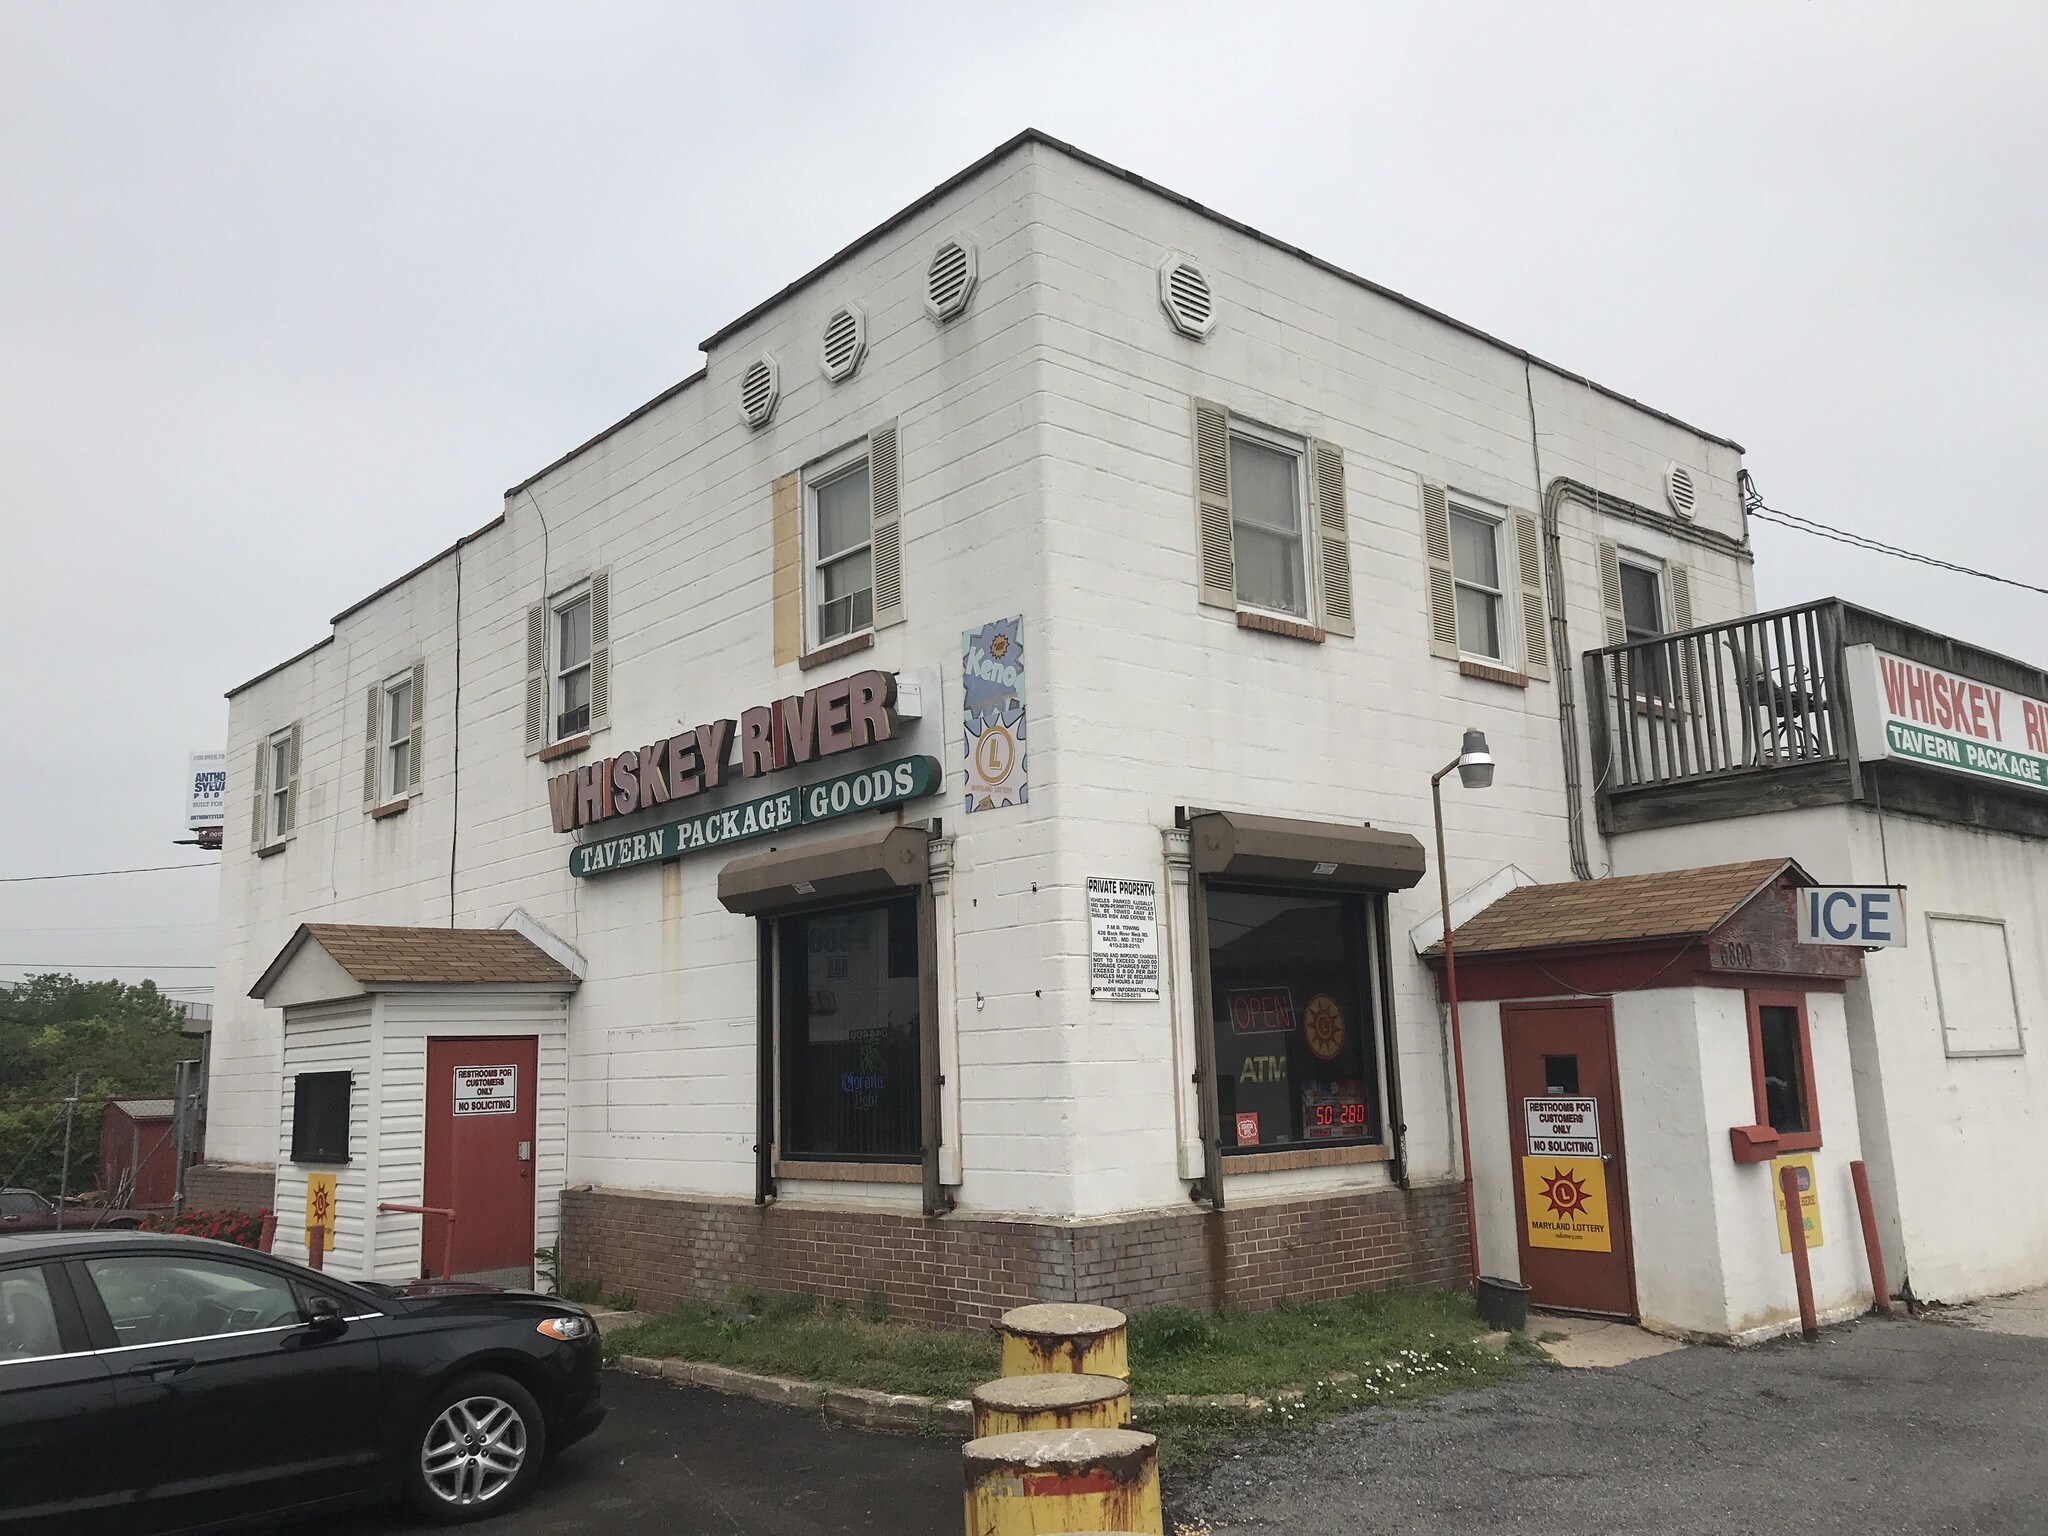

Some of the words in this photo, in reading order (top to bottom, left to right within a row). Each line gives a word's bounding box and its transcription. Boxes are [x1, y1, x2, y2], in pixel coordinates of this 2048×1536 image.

[965, 646, 1017, 687] Keno
[1879, 656, 2002, 742] WHISKEY
[547, 719, 737, 833] WHISKEY
[741, 669, 898, 778] RIVER
[1889, 724, 1961, 763] TAVERN
[1966, 744, 2041, 781] PACKAGE
[580, 828, 665, 873] TAVERN
[677, 798, 792, 851] PACKAGE
[808, 762, 914, 817] GOODS
[1089, 879, 1117, 894] PRIVATE
[1120, 882, 1152, 896] PROPERTY
[1811, 892, 1891, 941] ICE
[1234, 995, 1290, 1029] OPEN
[458, 1069, 498, 1079] RESTROOMS
[499, 1069, 512, 1077] FOR
[1239, 1055, 1287, 1084] ATM
[466, 1078, 505, 1087] CUSTOMERS
[477, 1087, 493, 1095] ONLY
[841, 1071, 884, 1094] Corona
[458, 1102, 470, 1111] NO
[471, 1100, 511, 1111] SOLICITING
[855, 1091, 881, 1112] Light
[1529, 1103, 1575, 1112] RESTROOMS
[1576, 1103, 1592, 1112] FOR
[1316, 1105, 1333, 1126] 50
[1340, 1104, 1365, 1124] 280
[1539, 1113, 1584, 1123] CUSTOMERS
[1552, 1125, 1571, 1134] ONLY
[1534, 1141, 1546, 1151] NO
[1547, 1141, 1594, 1152] SOLICITING
[1532, 1221, 1570, 1231] MARYLAND
[1573, 1223, 1604, 1233] LOTTERY
